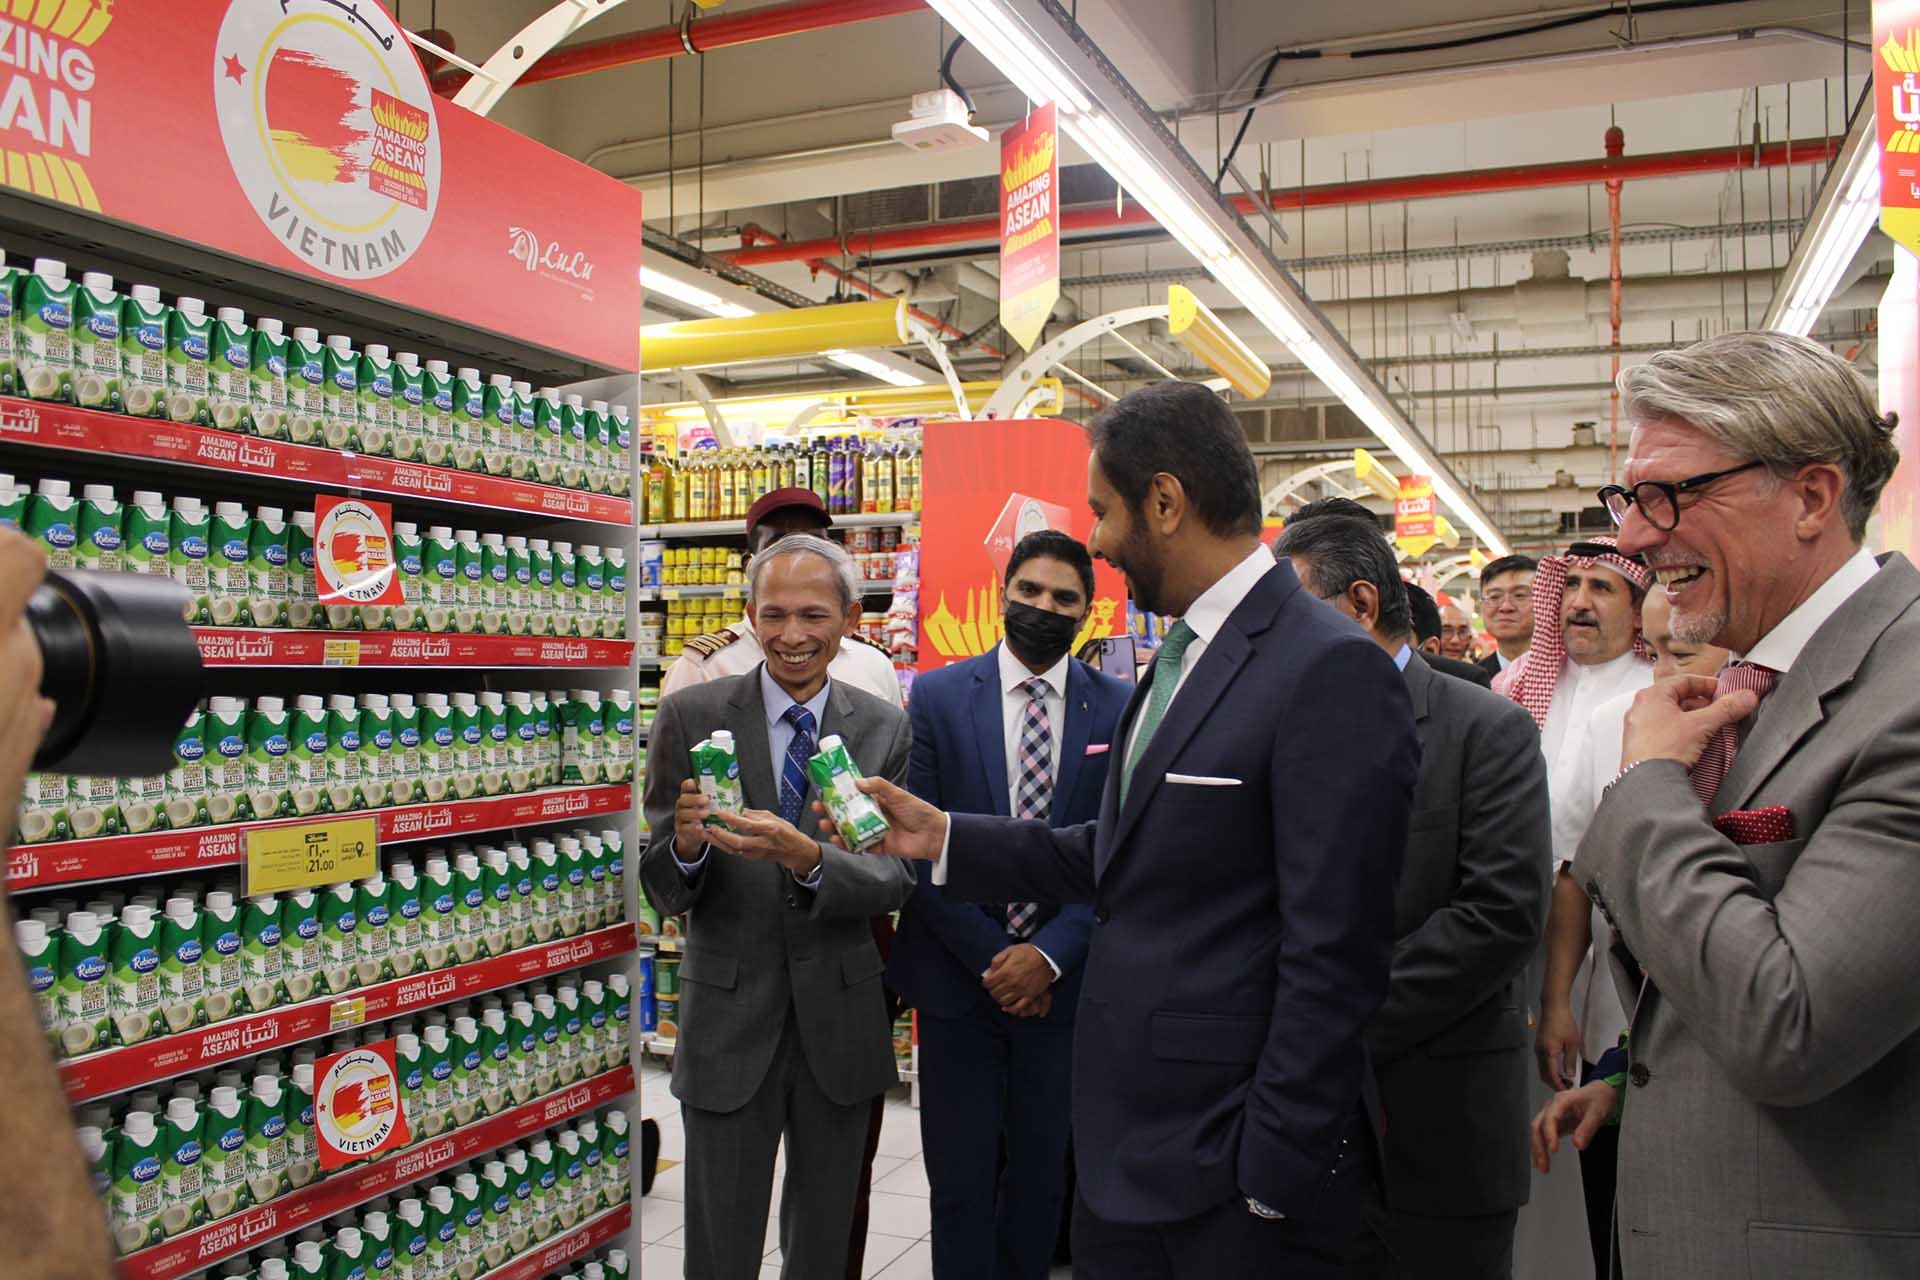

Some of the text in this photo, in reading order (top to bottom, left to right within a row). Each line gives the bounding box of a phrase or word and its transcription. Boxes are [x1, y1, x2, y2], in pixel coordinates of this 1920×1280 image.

[376, 126, 425, 155] AMAZING
[374, 140, 424, 174] ASEAN
[1008, 172, 1049, 210] AMAZING
[1005, 190, 1050, 236] ASEAN
[268, 191, 406, 271] VIETNAM
[539, 241, 593, 280] LuLu
[200, 435, 238, 449] AMAZING
[198, 446, 236, 463] ASEAN
[394, 467, 422, 478] AMAZING
[392, 475, 421, 489] ASEAN
[336, 581, 386, 599] VETNAM
[197, 636, 234, 645] AMAZING
[392, 637, 420, 647] AMAZING
[390, 646, 420, 658] ASEAN
[143, 782, 163, 791] WATER
[184, 778, 204, 788] WATER
[40, 790, 64, 799] WATER
[90, 786, 113, 796] WATER
[394, 812, 423, 822] AMAZING
[392, 820, 422, 833] ASEAN
[199, 833, 237, 845] AMAZING
[198, 843, 236, 858] ASEAN
[308, 860, 335, 872] 21.00
[397, 981, 426, 995] AMAZING
[137, 992, 157, 1001] WATER
[396, 989, 427, 1007] ASEAN
[82, 999, 105, 1011] WATER
[202, 1028, 240, 1046] AMAZING
[201, 1039, 239, 1059] ASEAN
[339, 1123, 390, 1151] VIETNAM
[396, 1151, 424, 1168] AMAZING
[395, 1160, 424, 1180] ASEAN
[136, 1200, 159, 1212] WATER
[199, 1223, 237, 1246] AMAZING
[198, 1233, 237, 1259] ASEAN
